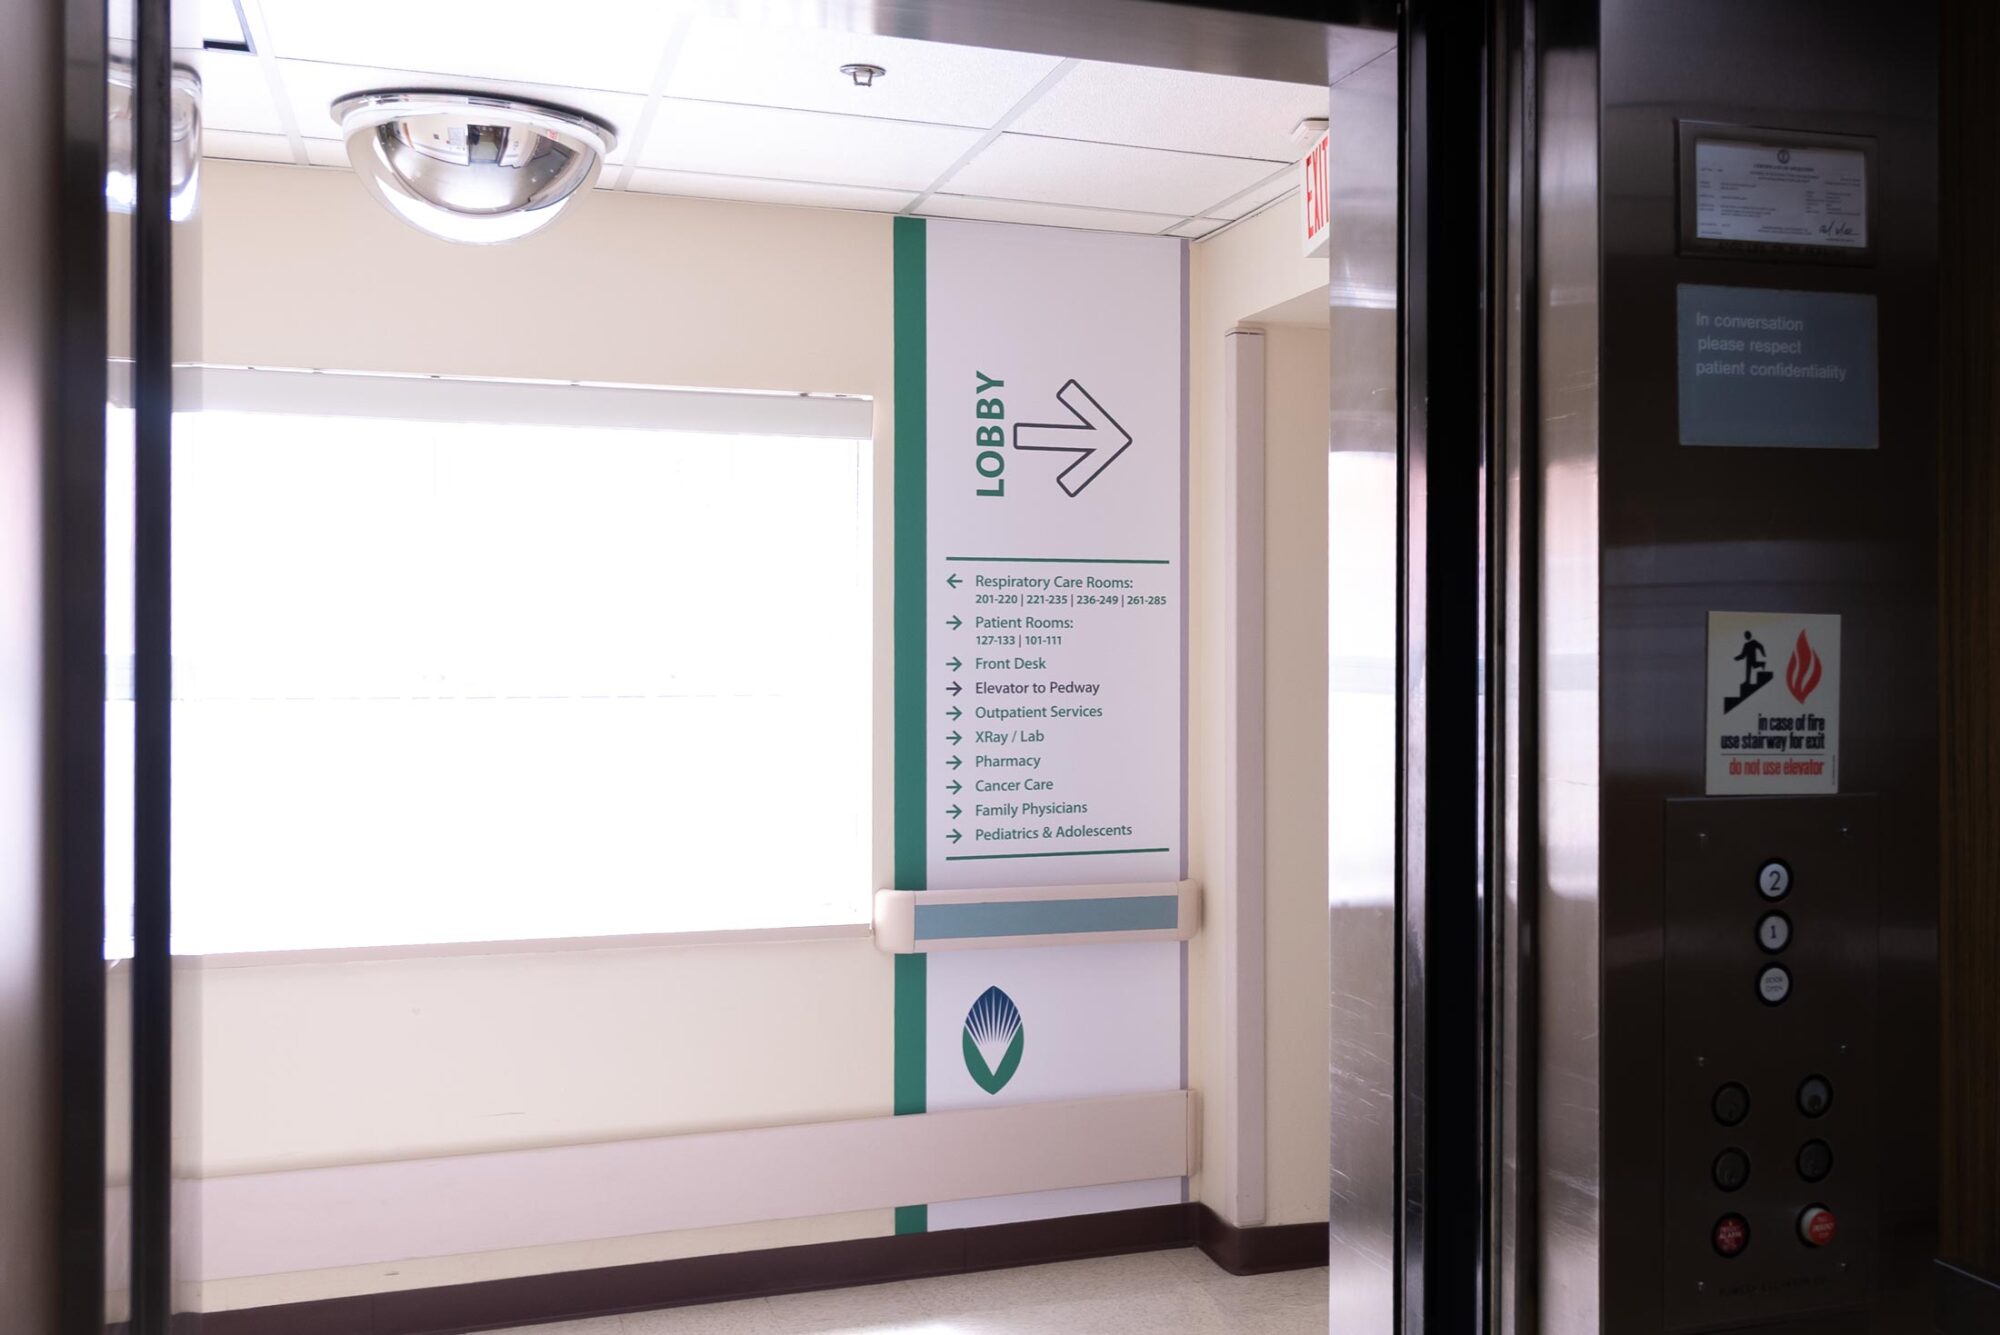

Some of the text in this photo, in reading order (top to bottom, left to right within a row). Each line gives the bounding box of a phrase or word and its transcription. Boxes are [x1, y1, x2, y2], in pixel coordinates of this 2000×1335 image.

[1696, 312, 1804, 331] In conversation
[1698, 336, 1802, 355] please respect
[1696, 361, 1847, 382] patient confidentiality
[976, 370, 1005, 496] LOBBY
[976, 574, 1133, 590] Respiratory Care Rooms:
[975, 594, 1018, 604] 201-220
[1026, 594, 1067, 604] 221-235
[1076, 595, 1119, 605] 236-249
[1127, 595, 1167, 605] 261-285
[975, 616, 1074, 629] Patient Rooms:
[976, 635, 1015, 645] 127-133
[1025, 636, 1062, 645] 101-111
[975, 657, 1046, 670] Front Desk
[975, 682, 1100, 696] Elevator to Pedway
[975, 706, 1103, 721] Outpatient Services
[1758, 713, 1825, 731] in case of fire
[975, 731, 1008, 745] XRay
[1020, 730, 1044, 743] Lab
[1721, 732, 1825, 752] use stairway for exit
[975, 755, 1041, 768] Pharmacy
[1729, 758, 1742, 775] do
[1744, 758, 1760, 775] not
[1763, 762, 1781, 775] use
[1784, 758, 1824, 775] elevator
[975, 779, 1053, 792] Cancer Care
[975, 801, 1088, 818] Family Physicians
[975, 824, 1132, 841] Pediatrics & Adolescents
[1769, 870, 1781, 891] 2
[1770, 925, 1776, 939] 1
